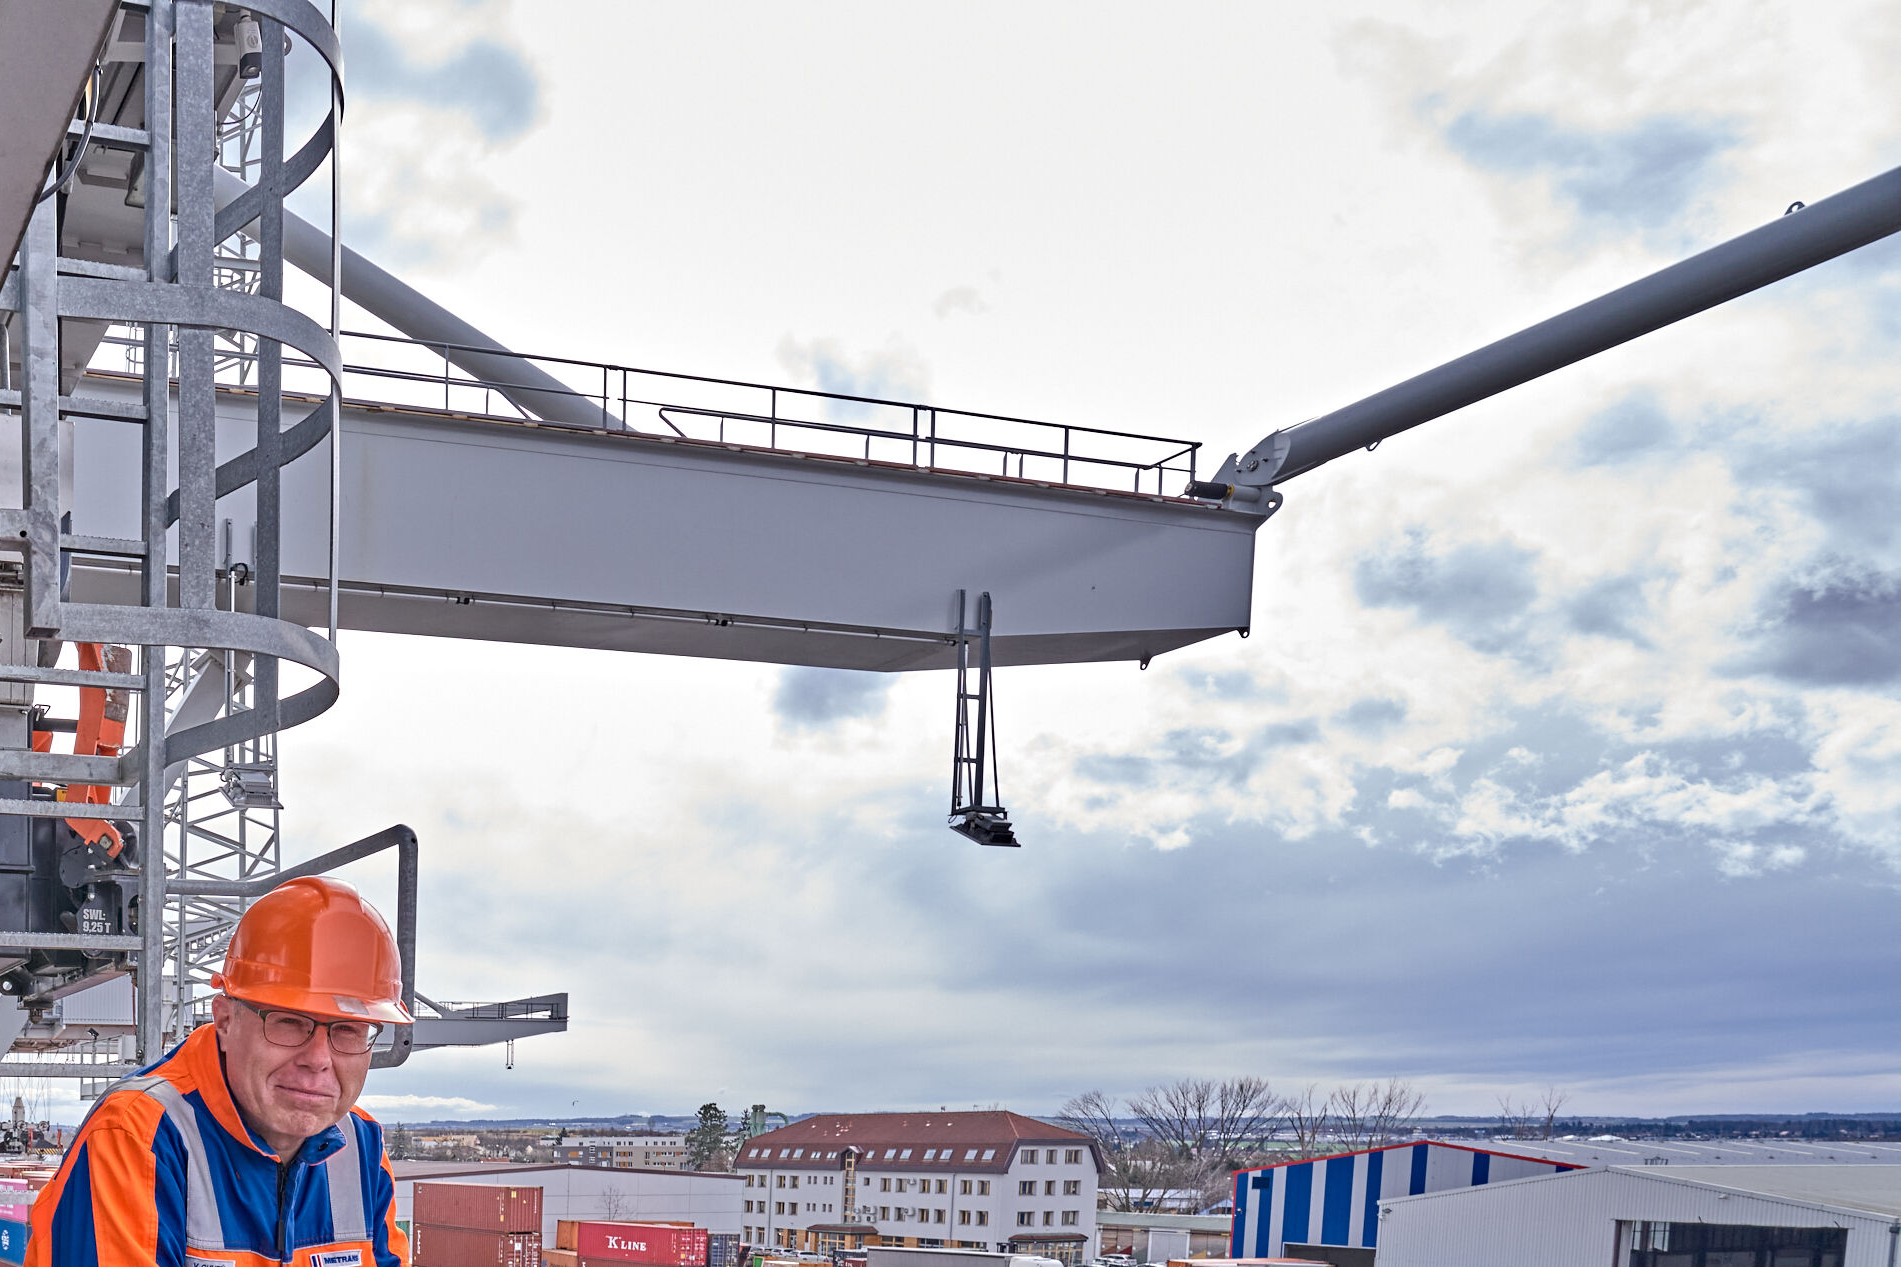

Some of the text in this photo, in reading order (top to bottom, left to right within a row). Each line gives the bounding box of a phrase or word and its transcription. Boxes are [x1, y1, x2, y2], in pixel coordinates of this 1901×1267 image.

[83, 908, 106, 921] SWL:
[83, 920, 111, 934] 9,25 T
[621, 1240, 647, 1252] LINE
[323, 1254, 359, 1265] METRANS
